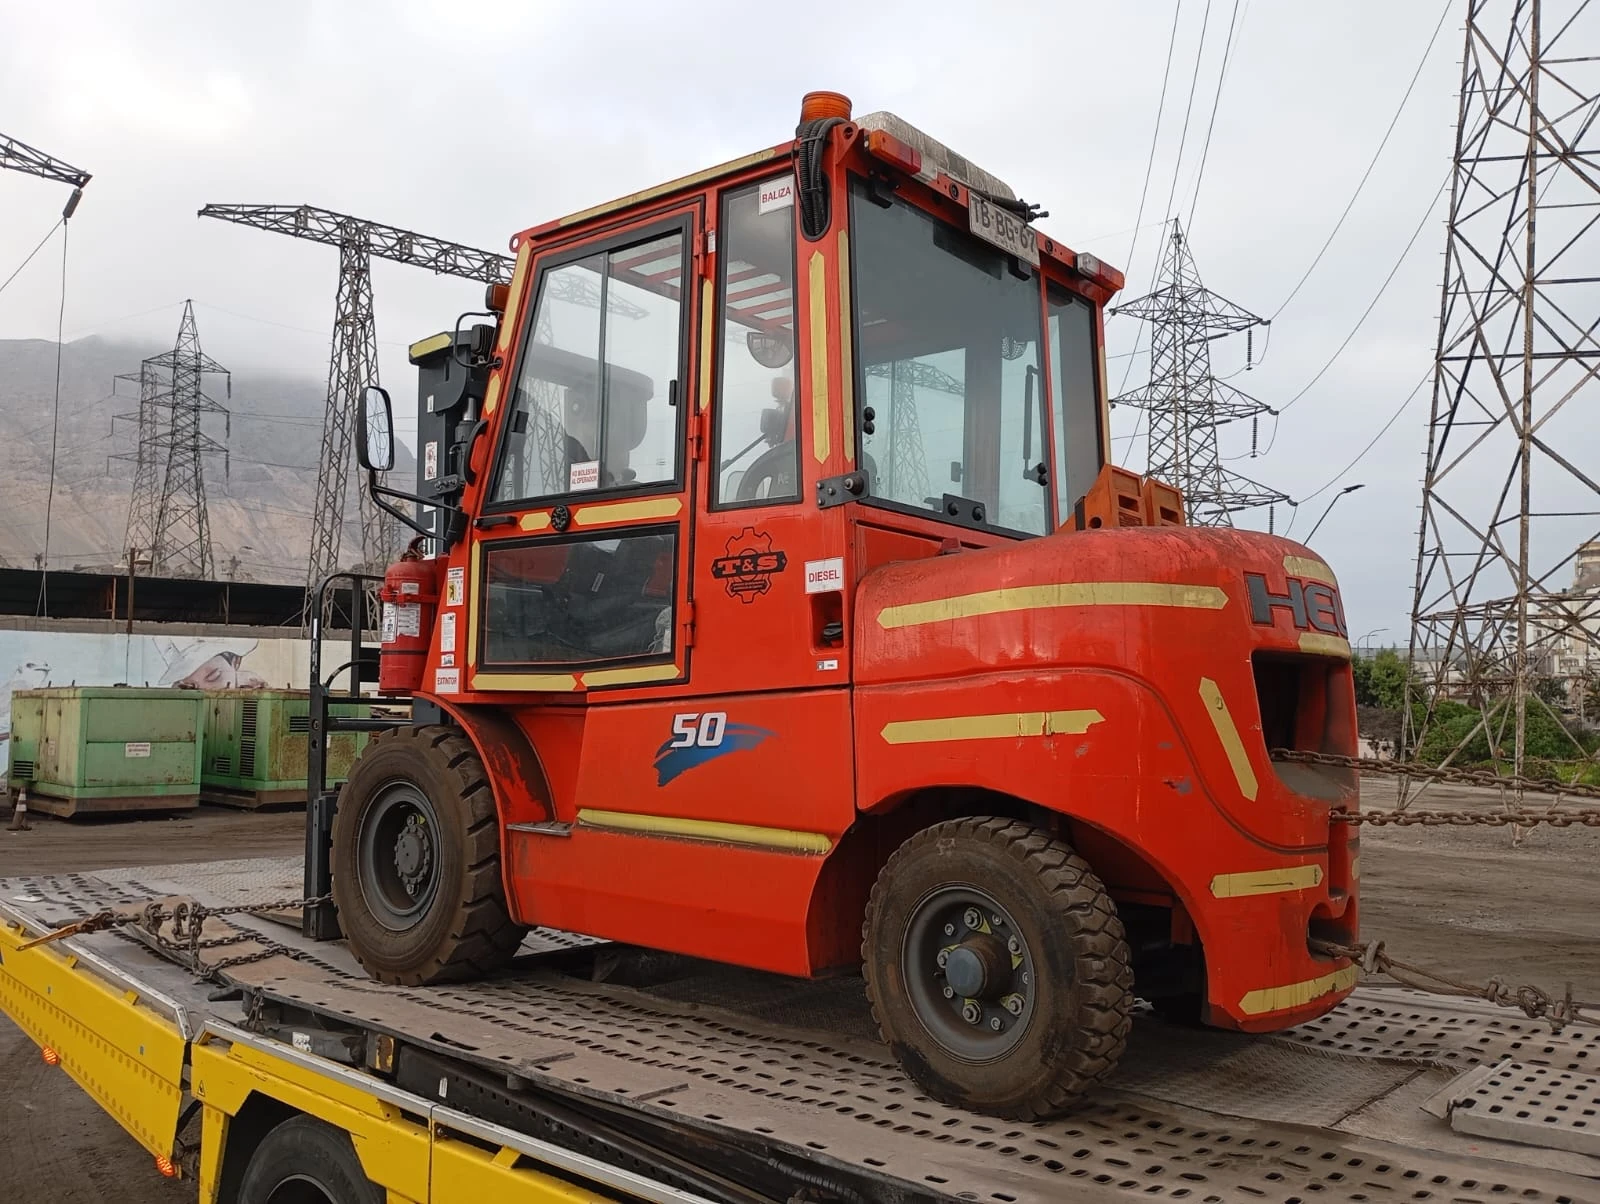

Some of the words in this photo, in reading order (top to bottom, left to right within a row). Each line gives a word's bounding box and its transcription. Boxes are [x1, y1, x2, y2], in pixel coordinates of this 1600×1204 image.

[762, 186, 791, 203] BALIZA
[808, 570, 840, 582] DIESEL
[670, 711, 727, 747] 50
